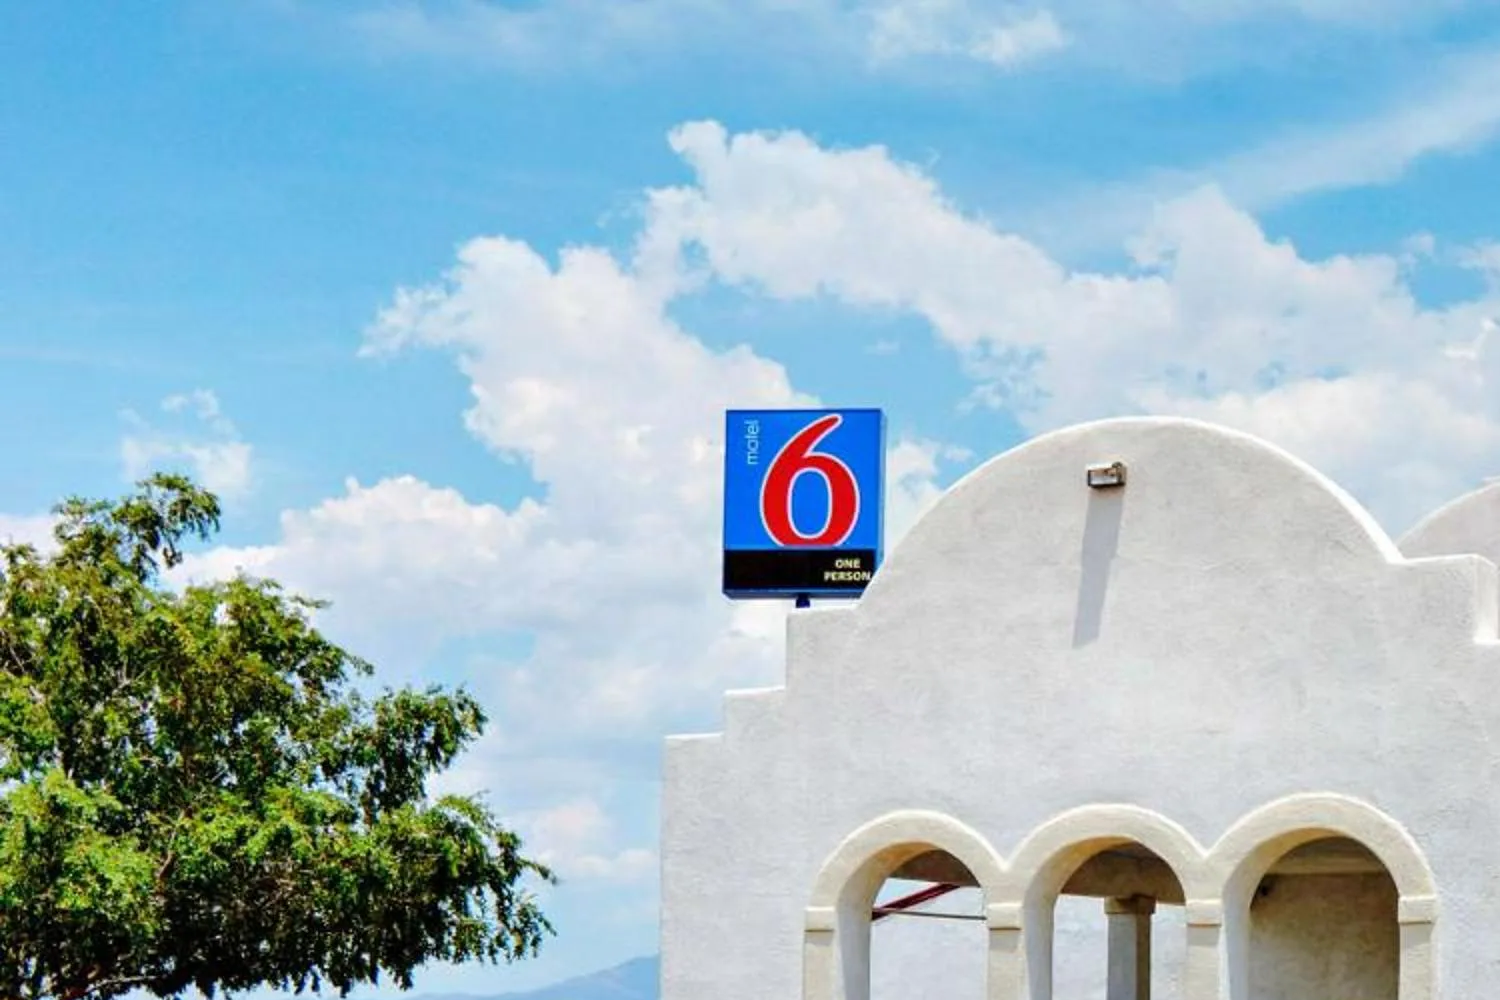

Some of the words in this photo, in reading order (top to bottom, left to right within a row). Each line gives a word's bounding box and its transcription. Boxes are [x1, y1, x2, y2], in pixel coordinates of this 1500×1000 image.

[743, 419, 759, 465] motel
[760, 414, 860, 547] 6
[835, 558, 861, 569] ONE
[823, 571, 872, 582] PERSON
